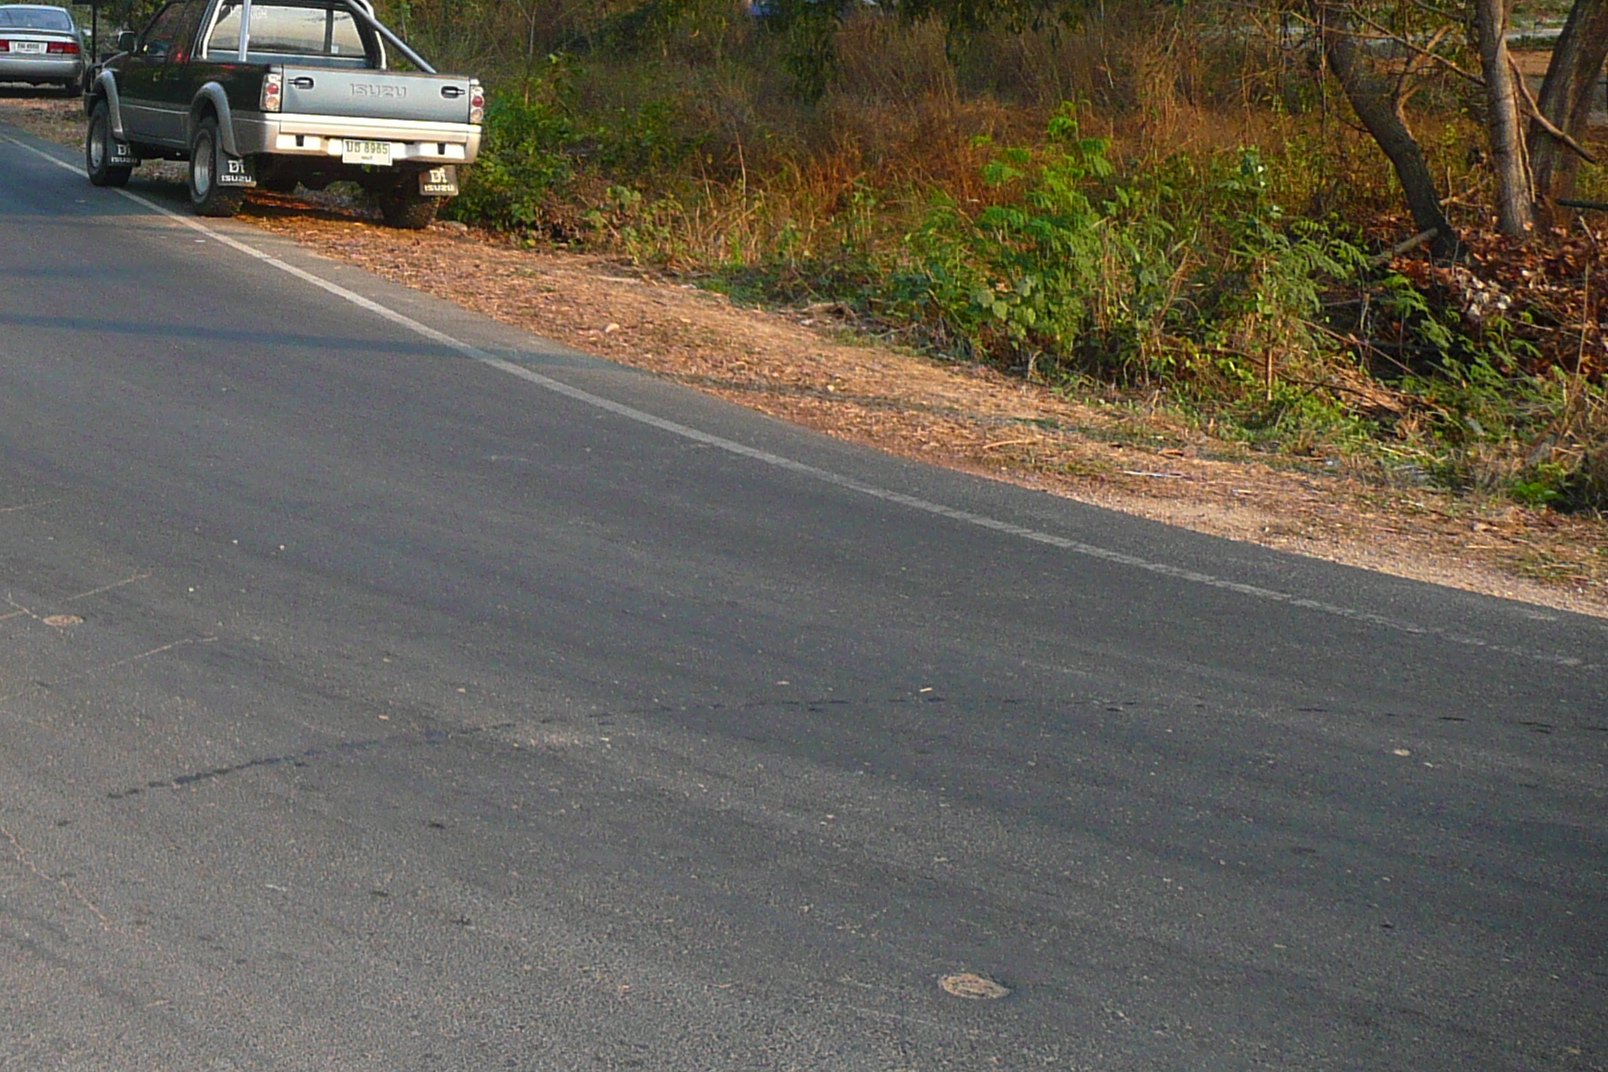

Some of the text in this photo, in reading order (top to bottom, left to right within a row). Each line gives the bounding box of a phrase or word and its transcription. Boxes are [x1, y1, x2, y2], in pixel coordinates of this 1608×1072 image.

[350, 83, 407, 98] ISUZU
[111, 156, 138, 164] ISUZU
[221, 175, 252, 183] ISUZU
[424, 184, 454, 192] ISUZU
